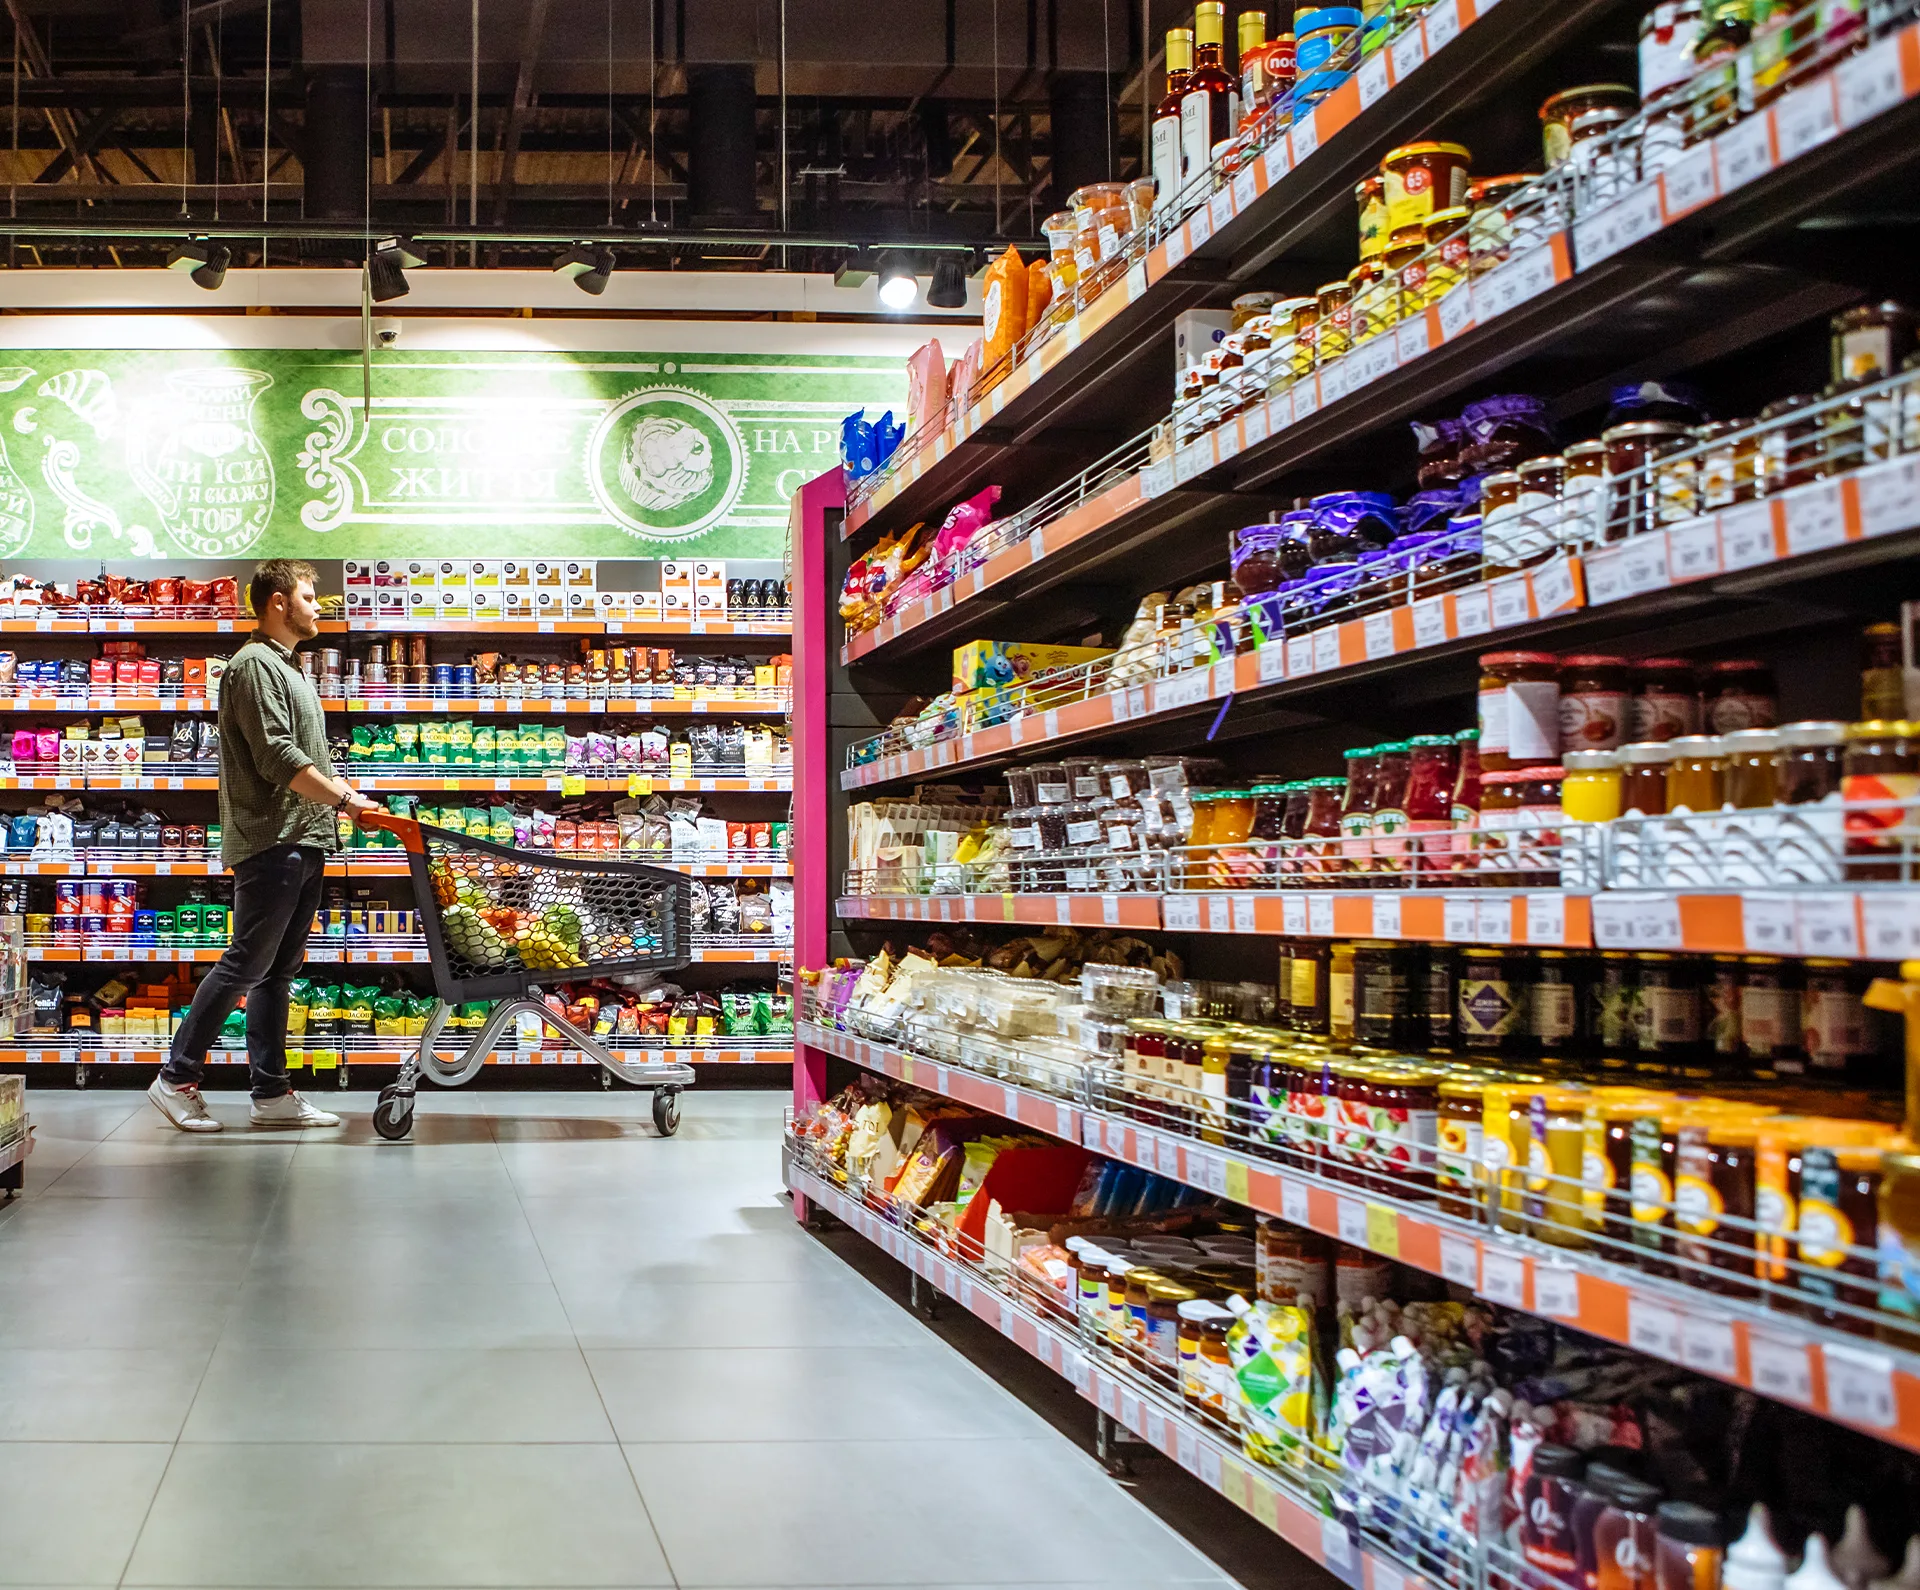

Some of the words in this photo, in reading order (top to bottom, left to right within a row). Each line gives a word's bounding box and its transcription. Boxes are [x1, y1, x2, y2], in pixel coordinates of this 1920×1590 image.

[1406, 171, 1423, 188] 65
[381, 427, 571, 454] СОЛОЕ
[753, 429, 803, 453] НА
[164, 459, 202, 484] ТИ
[214, 458, 269, 484] ЇСИ
[387, 467, 560, 498] ЖИТТЯ
[187, 486, 201, 502] Я
[187, 507, 243, 533] ТОБІ
[170, 520, 223, 554] ХТО
